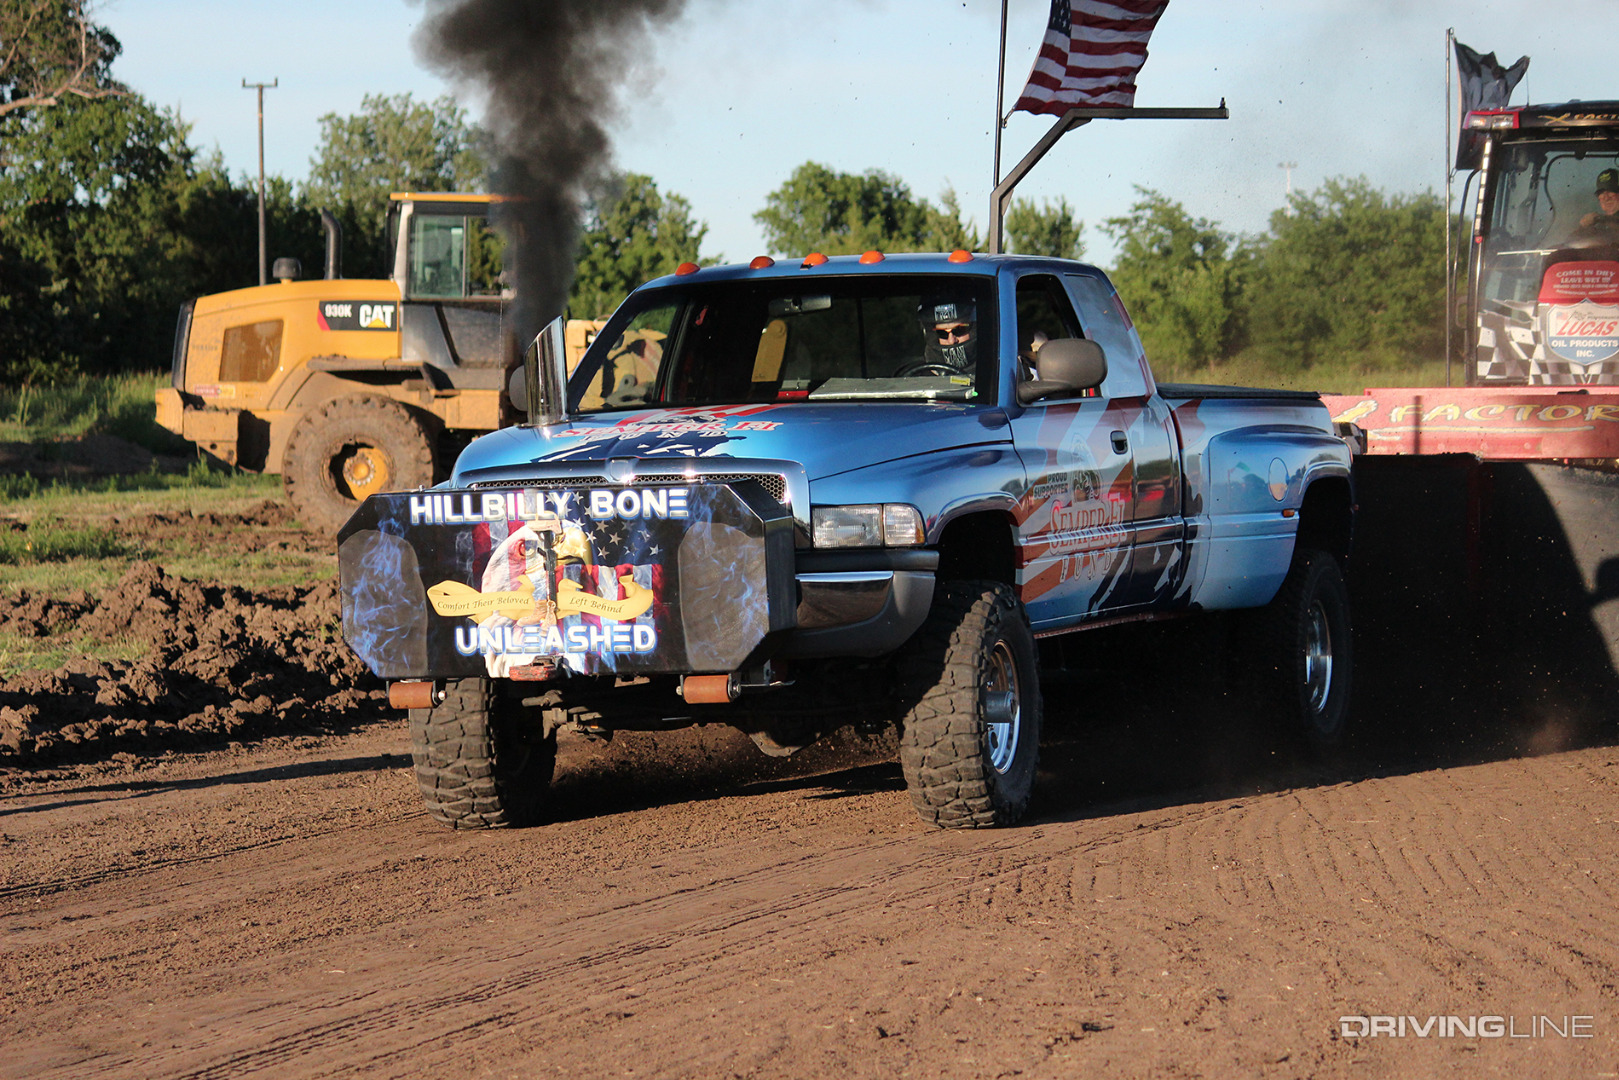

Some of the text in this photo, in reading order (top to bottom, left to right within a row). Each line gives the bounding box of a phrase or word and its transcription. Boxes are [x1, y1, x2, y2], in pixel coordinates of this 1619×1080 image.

[1574, 113, 1619, 121] FACT
[1556, 269, 1582, 277] COME
[1560, 276, 1583, 284] LEAVE
[325, 303, 395, 328] 930K CAT
[1556, 320, 1618, 336] LUCAS
[1551, 339, 1619, 347] OIL PRODUCTS
[1576, 349, 1595, 357] INC.
[556, 420, 784, 438] SEMPER FI
[1048, 472, 1067, 483] PROUD
[1034, 483, 1068, 498] SUPPORTER
[410, 488, 690, 525] HILLBILLY BONE
[1050, 496, 1127, 552] SEMPER FI
[1059, 549, 1113, 582] FUND
[437, 596, 530, 612] Comfort Their Beloved
[569, 596, 624, 614] Left Behind
[455, 624, 656, 656] UNLEASHED
